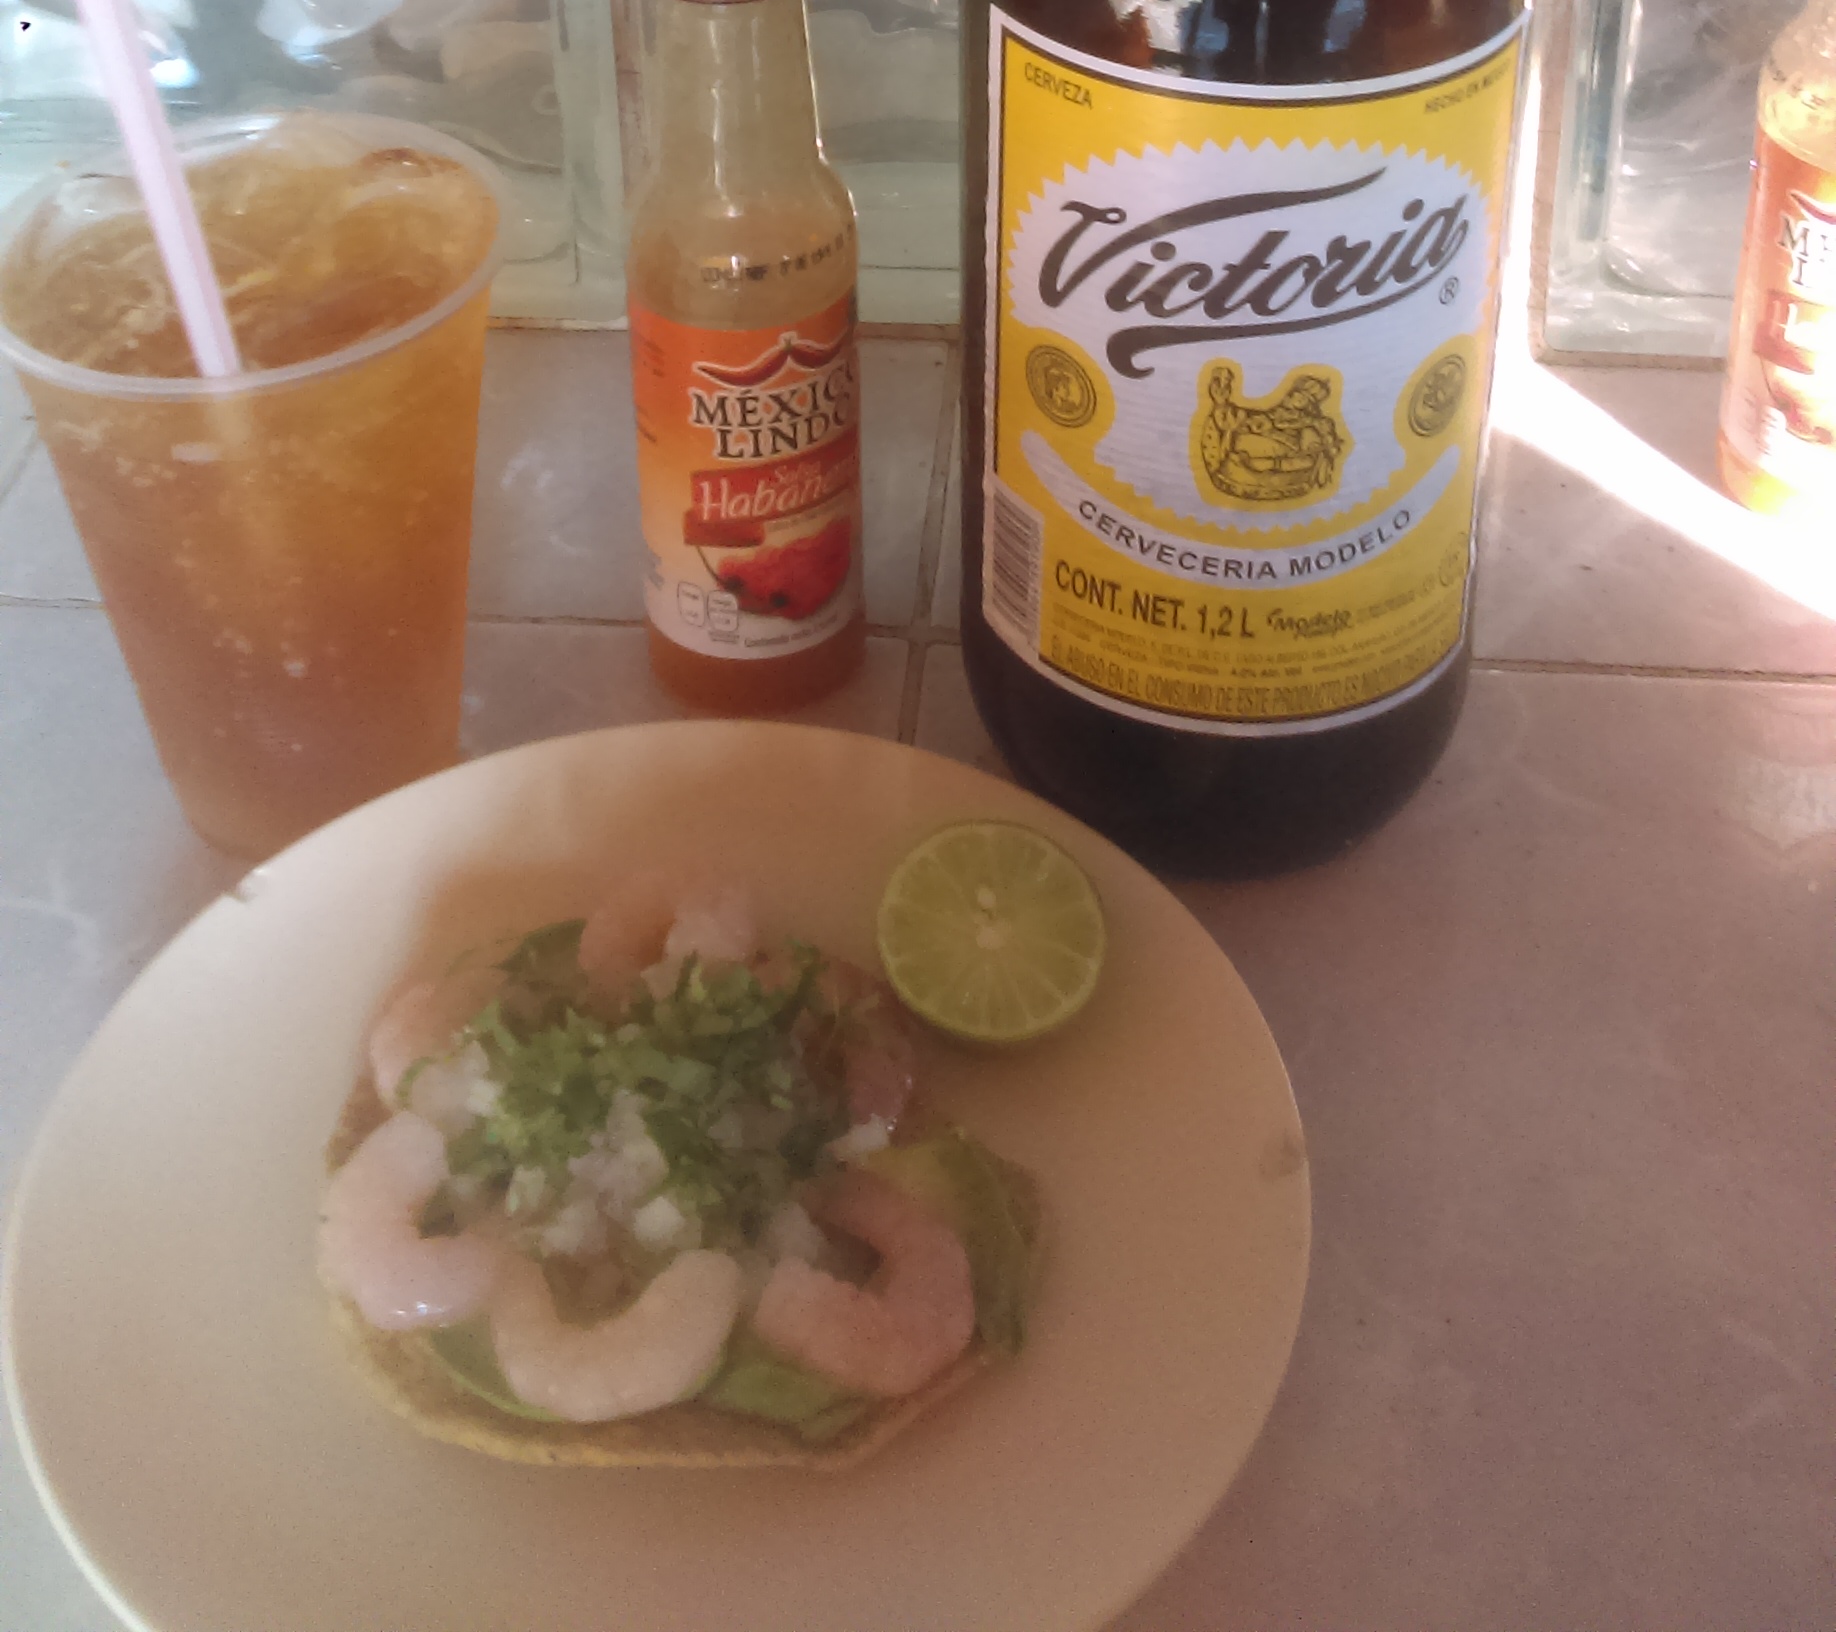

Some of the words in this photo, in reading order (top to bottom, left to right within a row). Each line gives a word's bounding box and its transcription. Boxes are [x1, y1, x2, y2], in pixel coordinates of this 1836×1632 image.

[1024, 62, 1093, 110] CERVEZA
[1038, 166, 1470, 379] Victoria
[1078, 499, 1277, 580] CERVECERIA
[1289, 509, 1411, 577] MODELO
[1055, 559, 1123, 616] CONT.
[1132, 588, 1188, 632] NET.
[1197, 604, 1233, 641] 1,2
[1240, 606, 1256, 639] L
[1108, 662, 1124, 690] EN
[1128, 671, 1141, 698] EL
[1145, 674, 1213, 709] CONSUMO
[1216, 685, 1233, 713] DE
[1236, 686, 1270, 714] ESTE
